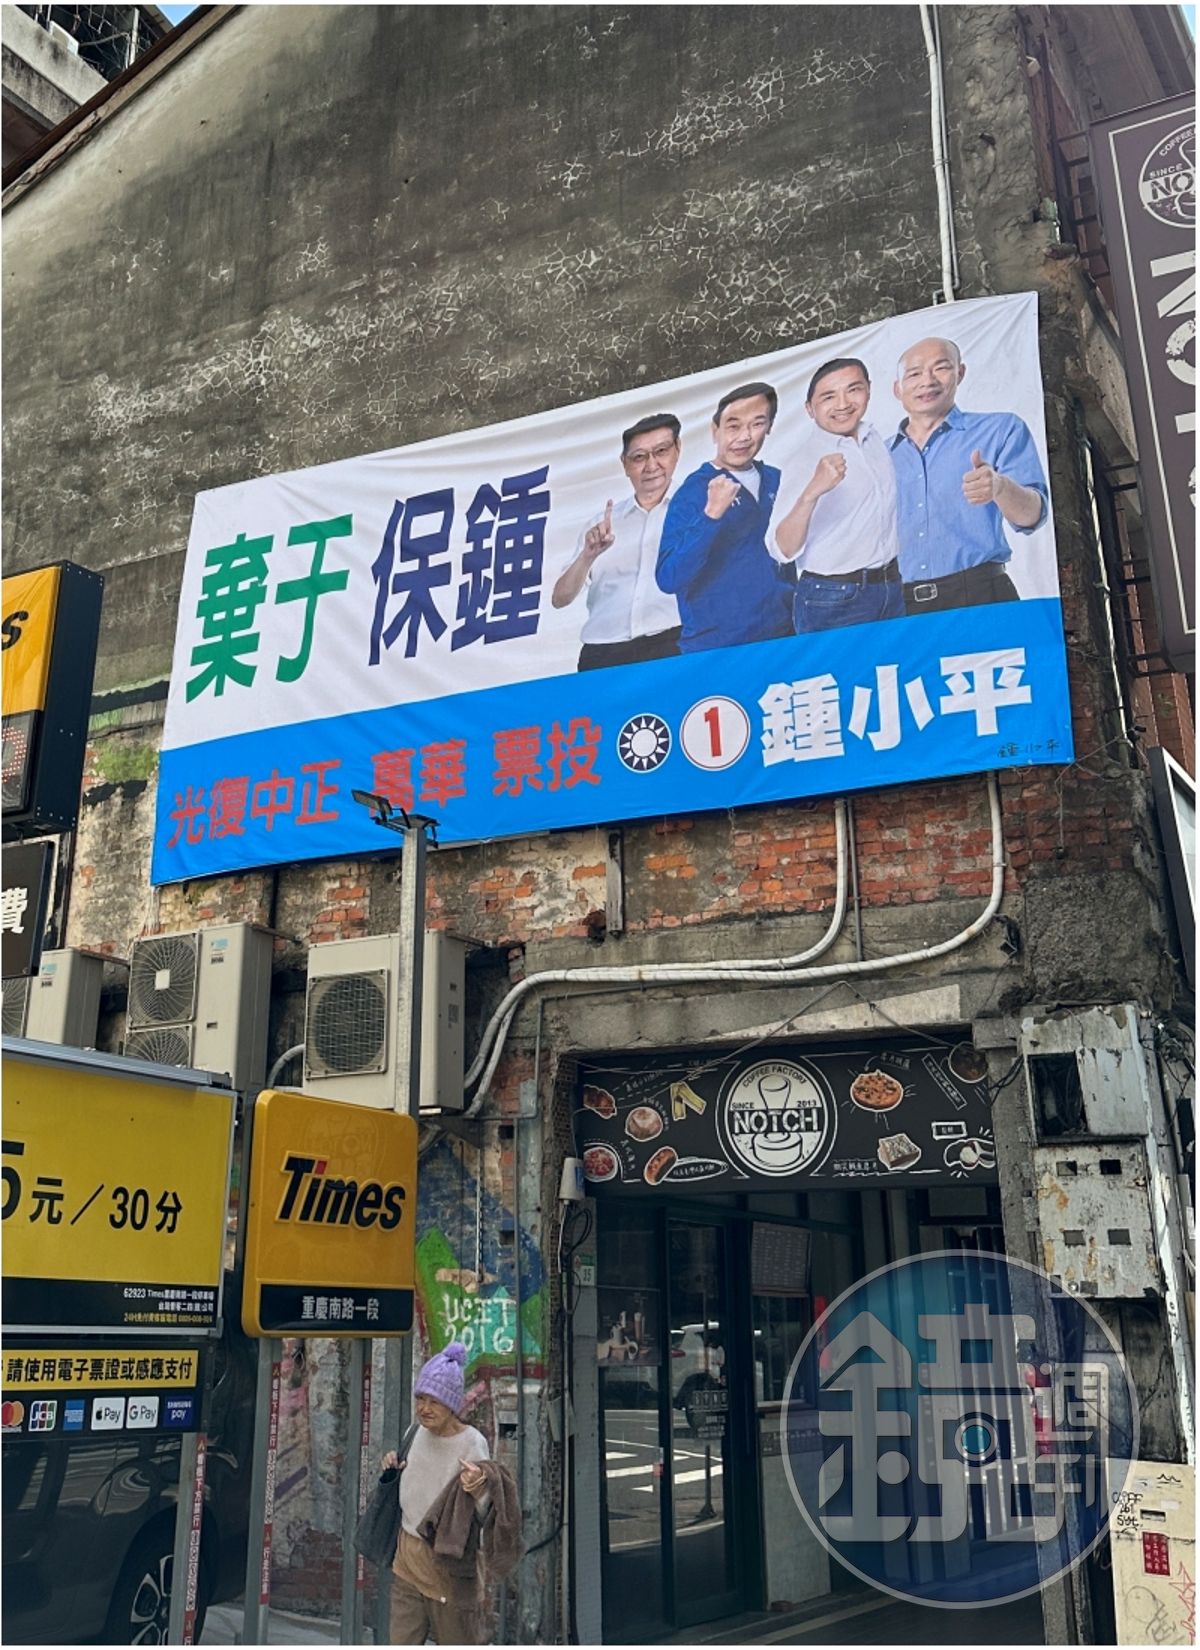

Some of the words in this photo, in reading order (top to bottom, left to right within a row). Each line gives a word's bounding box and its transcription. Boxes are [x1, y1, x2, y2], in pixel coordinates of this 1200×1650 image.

[1149, 163, 1183, 179] SINCE
[185, 513, 353, 704] 棄于
[368, 465, 550, 666] 保鍾
[371, 738, 467, 817] 萬華
[492, 716, 602, 797] 票投
[704, 706, 722, 758] 1
[758, 647, 1032, 768] 鍾小平
[742, 1066, 770, 1088] COFFEE
[771, 1065, 808, 1085] FACTORY
[731, 1102, 755, 1110] SINCE
[733, 1109, 819, 1134] NOTCH
[278, 1154, 407, 1231] Times
[301, 1295, 380, 1321] 重慶南路一段
[444, 1324, 515, 1355] 2016
[6, 1358, 193, 1382] 請使用電子票證或感應支付
[30, 1410, 55, 1422] JCB
[104, 1407, 121, 1424] Pay
[140, 1405, 157, 1422] Pay
[171, 1409, 187, 1421] pay
